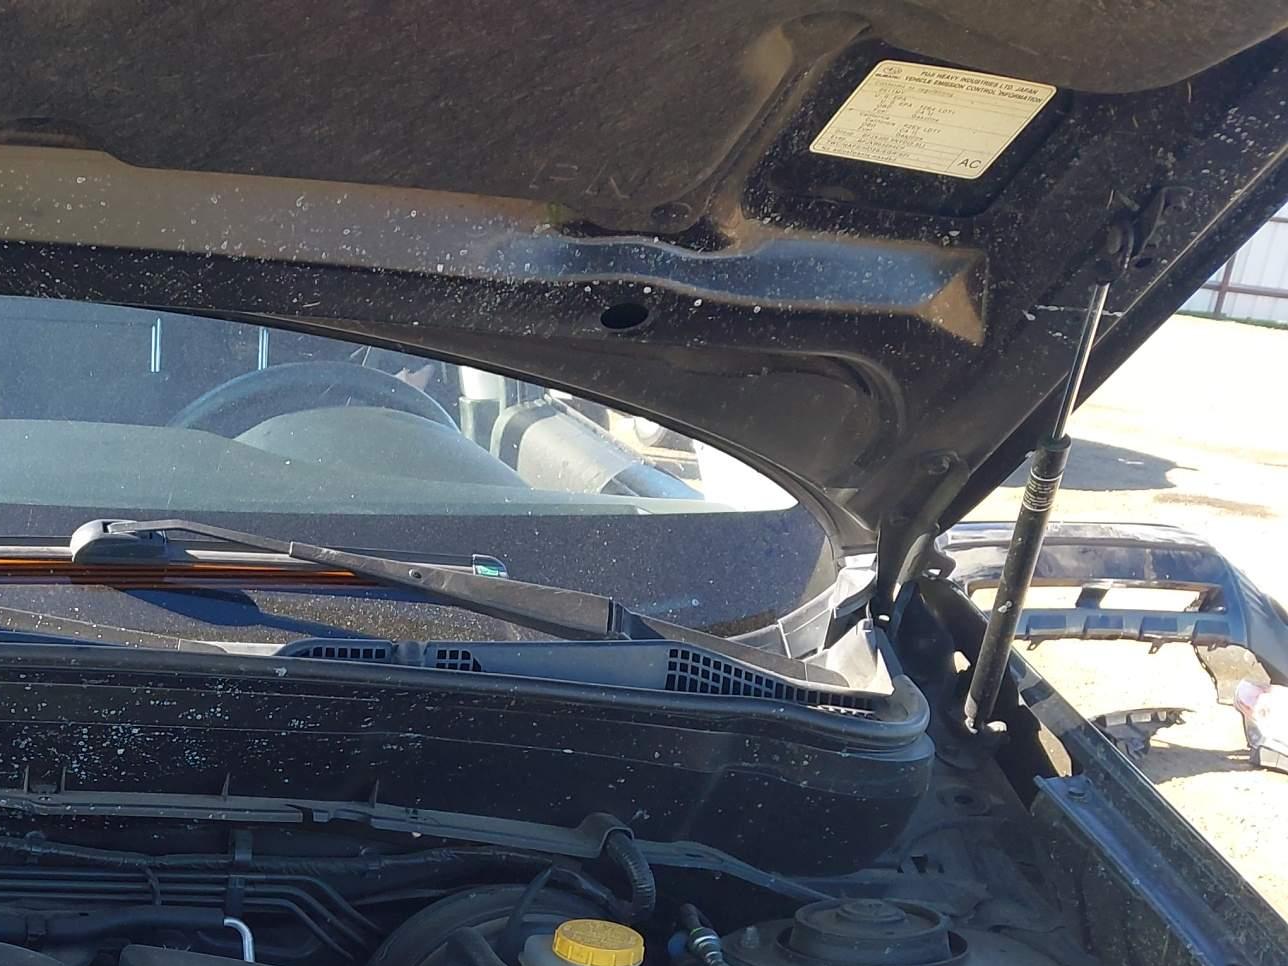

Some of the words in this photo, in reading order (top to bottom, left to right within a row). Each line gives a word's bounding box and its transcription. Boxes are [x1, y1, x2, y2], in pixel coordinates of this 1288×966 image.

[905, 76, 931, 84] VEHICLE
[933, 79, 965, 90] EMISSION
[966, 84, 997, 95] CONTROL
[998, 90, 1042, 103] INFORMATION
[937, 73, 959, 82] HEAVY
[961, 76, 998, 88] INDUSTRIES
[1015, 86, 1040, 95] JAPAN
[957, 158, 981, 169] AC
